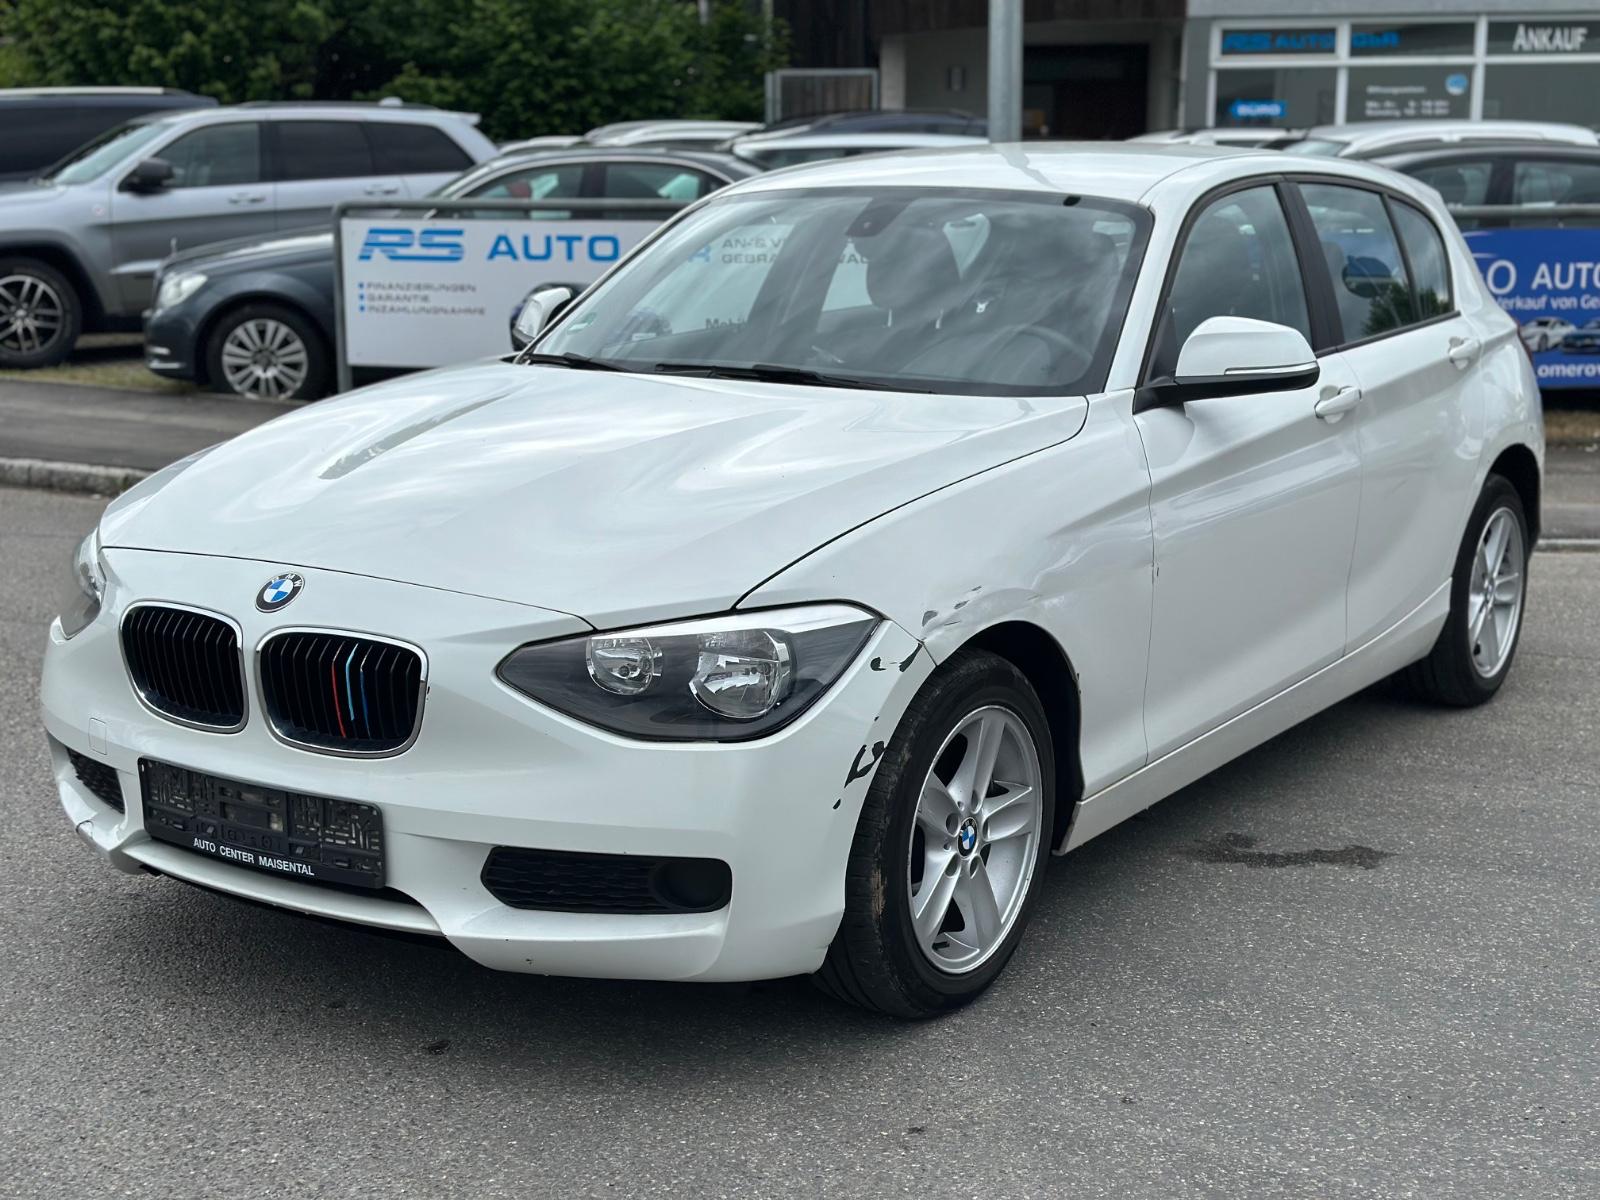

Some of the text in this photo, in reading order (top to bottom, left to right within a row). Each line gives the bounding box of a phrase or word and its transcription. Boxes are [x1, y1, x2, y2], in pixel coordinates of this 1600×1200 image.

[1512, 23, 1588, 51] ANKAUF
[358, 228, 465, 262] RS
[486, 234, 620, 262] AUTO
[1497, 295, 1548, 310] erkauf
[1551, 297, 1577, 310] von
[193, 838, 315, 876] AUTO CENTER MAISENTAL
